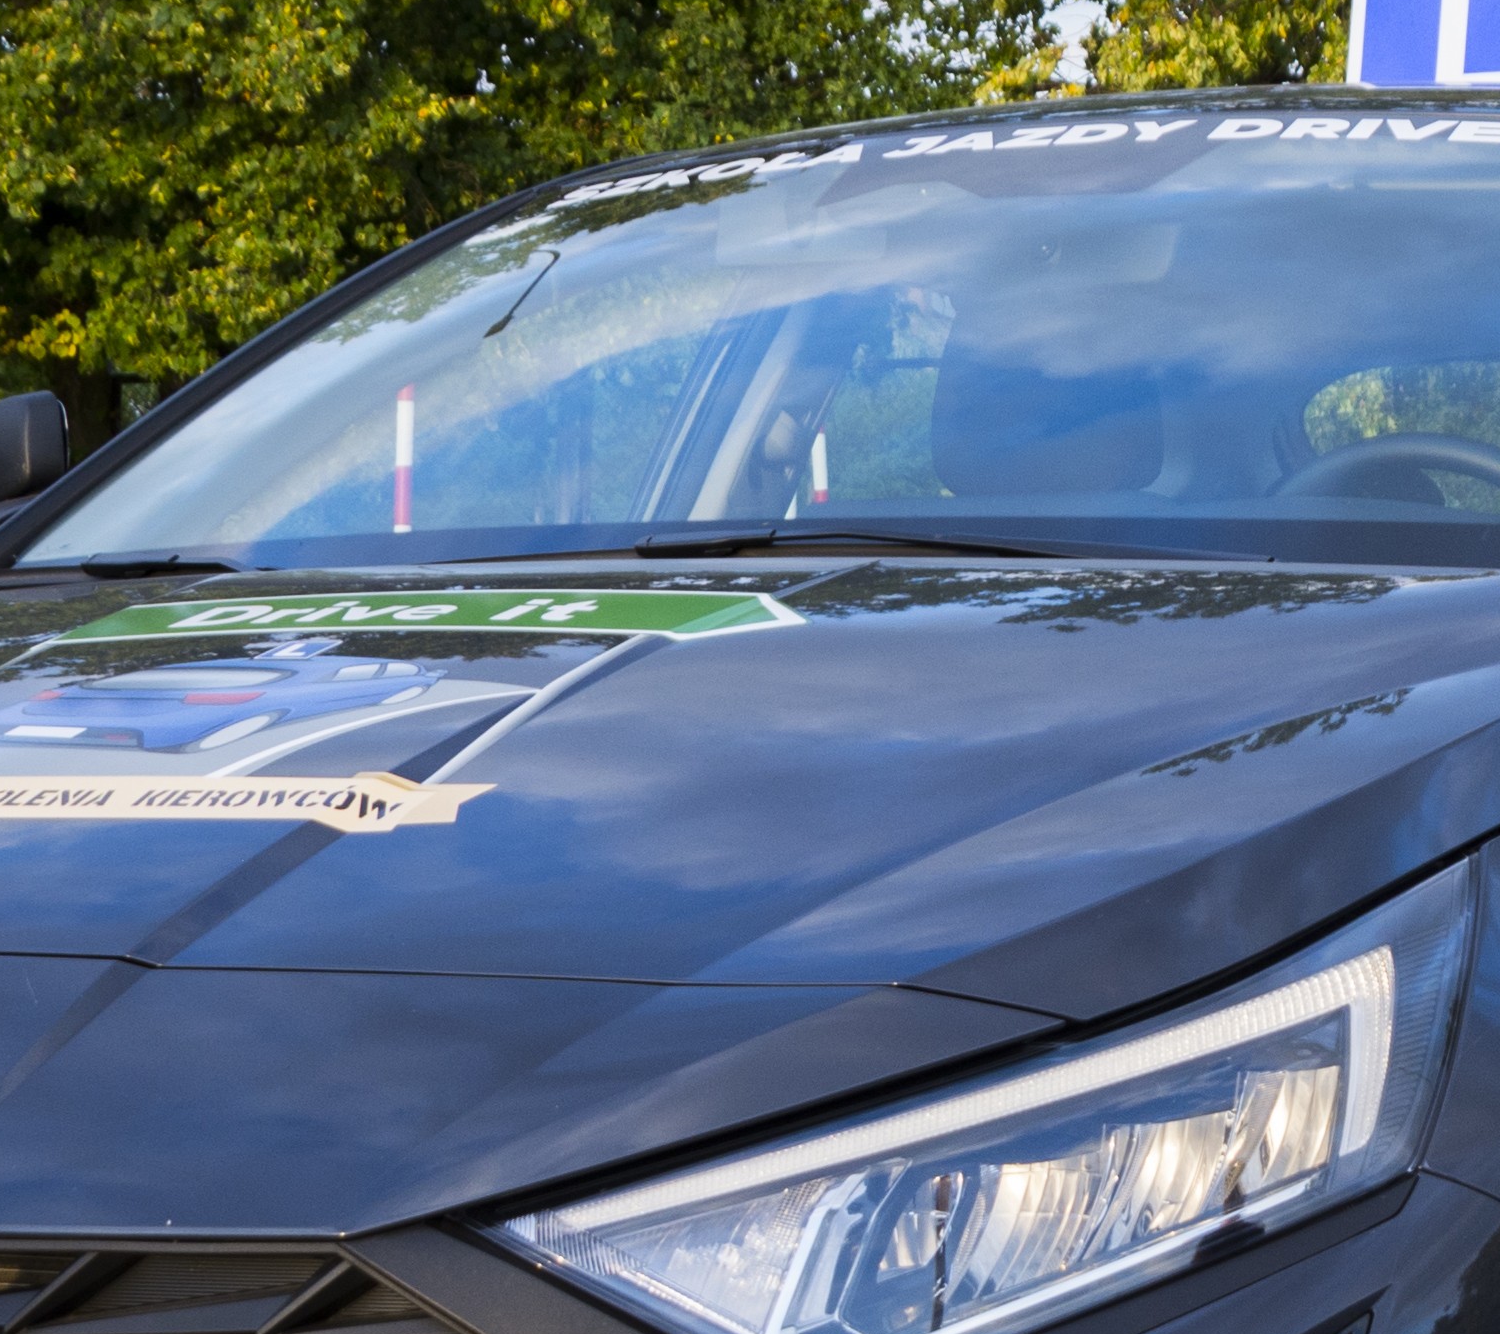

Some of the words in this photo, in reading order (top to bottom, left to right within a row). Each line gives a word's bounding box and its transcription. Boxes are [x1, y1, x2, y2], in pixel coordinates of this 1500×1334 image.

[546, 143, 864, 210] SZKOŁA
[882, 119, 1198, 159] JAZDY
[168, 601, 458, 628] Drive
[489, 598, 598, 622] it
[131, 785, 404, 820] KIEROWCÓW
